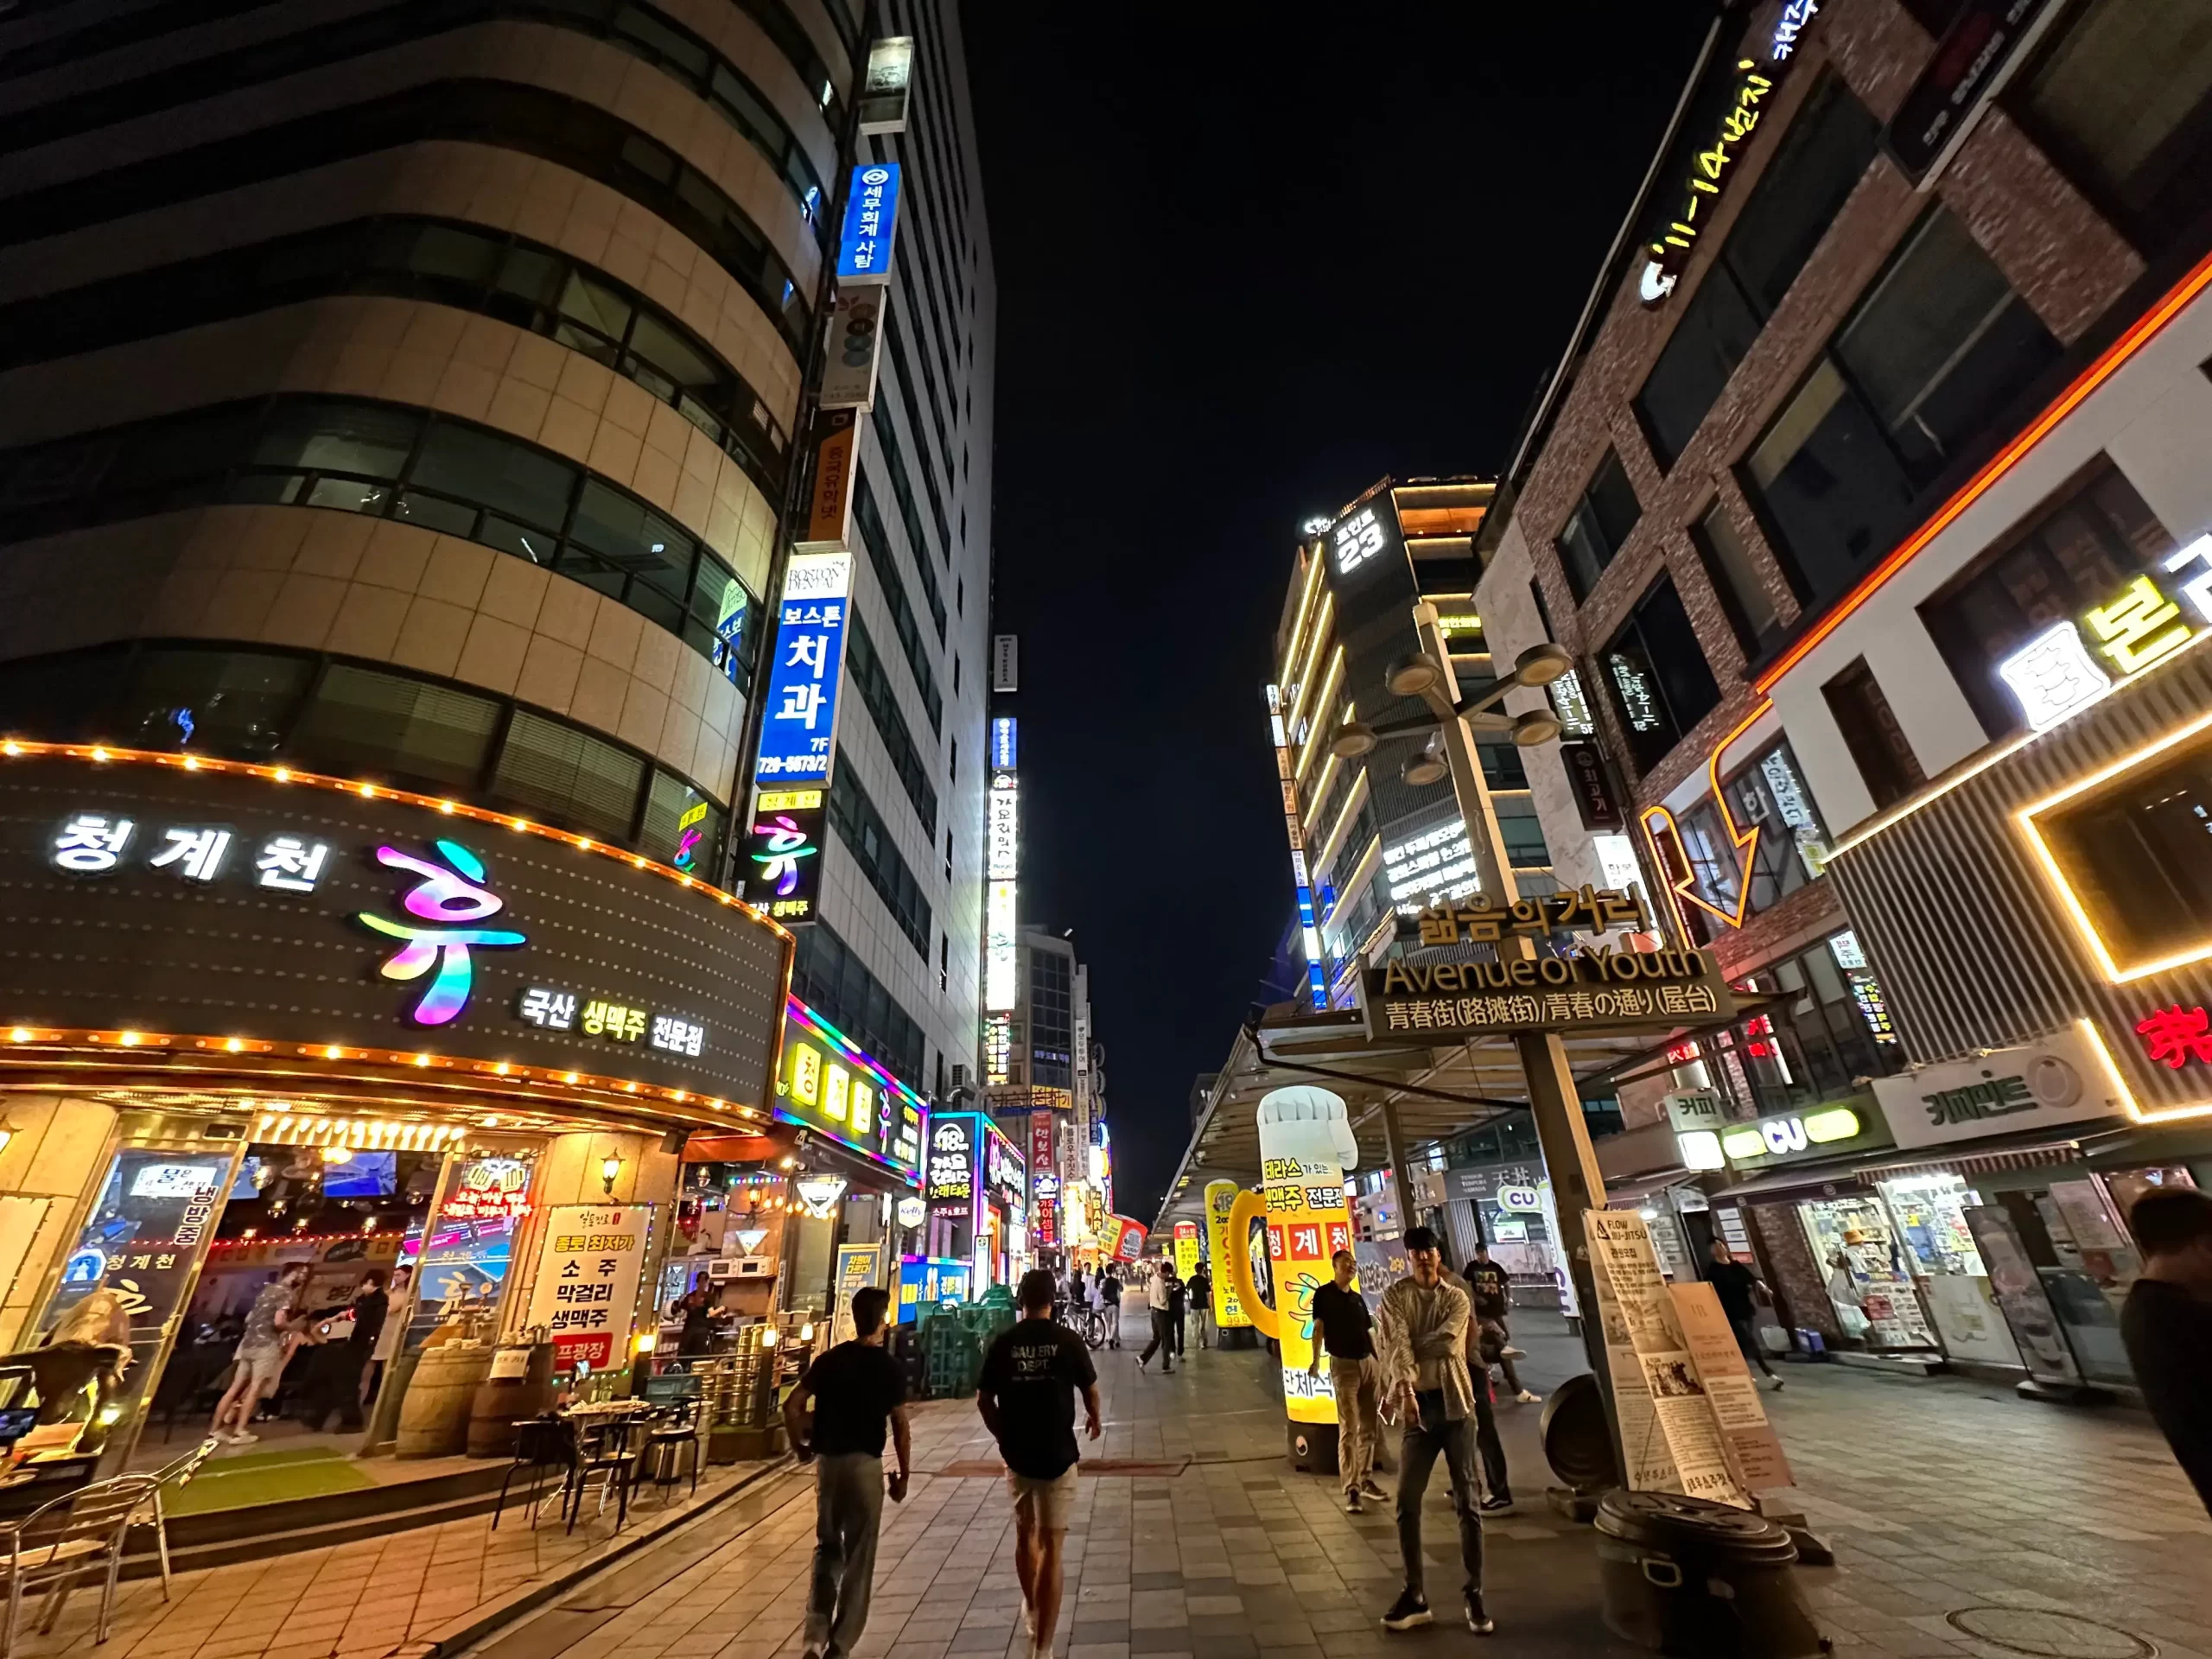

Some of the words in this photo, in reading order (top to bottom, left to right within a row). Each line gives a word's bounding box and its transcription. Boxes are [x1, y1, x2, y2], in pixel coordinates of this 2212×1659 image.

[858, 185, 884, 238] 세무회계
[854, 240, 874, 270] 사람
[1338, 523, 1383, 575] 23
[783, 606, 842, 628] 보스톤
[774, 633, 830, 730] 치과
[1580, 723, 1594, 735] 5F
[810, 737, 829, 753] 7F
[54, 814, 334, 893] 청계천
[1418, 890, 1549, 946] 젊음의
[1555, 881, 1650, 937] 거리
[1382, 957, 1536, 996] Avenue
[1541, 946, 1583, 983] of
[1583, 944, 1708, 984] Youth
[523, 988, 576, 1032] 국산
[580, 998, 647, 1044] 생맥주
[651, 1014, 705, 1058] 전문점
[1677, 1096, 1717, 1116] 커피
[940, 1130, 960, 1152] 18
[1762, 1117, 1808, 1154] CU
[929, 1183, 971, 1199] 노래타운
[1306, 1186, 1344, 1211] 전문점
[1510, 1192, 1535, 1206] CU
[173, 1185, 219, 1246] 냉방중
[1092, 1198, 1102, 1230] BAR
[1607, 1220, 1628, 1230] FLOW
[555, 1236, 586, 1253] 종로
[587, 1234, 636, 1252] 최저가
[1611, 1230, 1648, 1241] JIU-JITSU
[105, 1254, 176, 1270] 청계천
[556, 1283, 614, 1304] 막걸리
[551, 1308, 609, 1330] 생맥주
